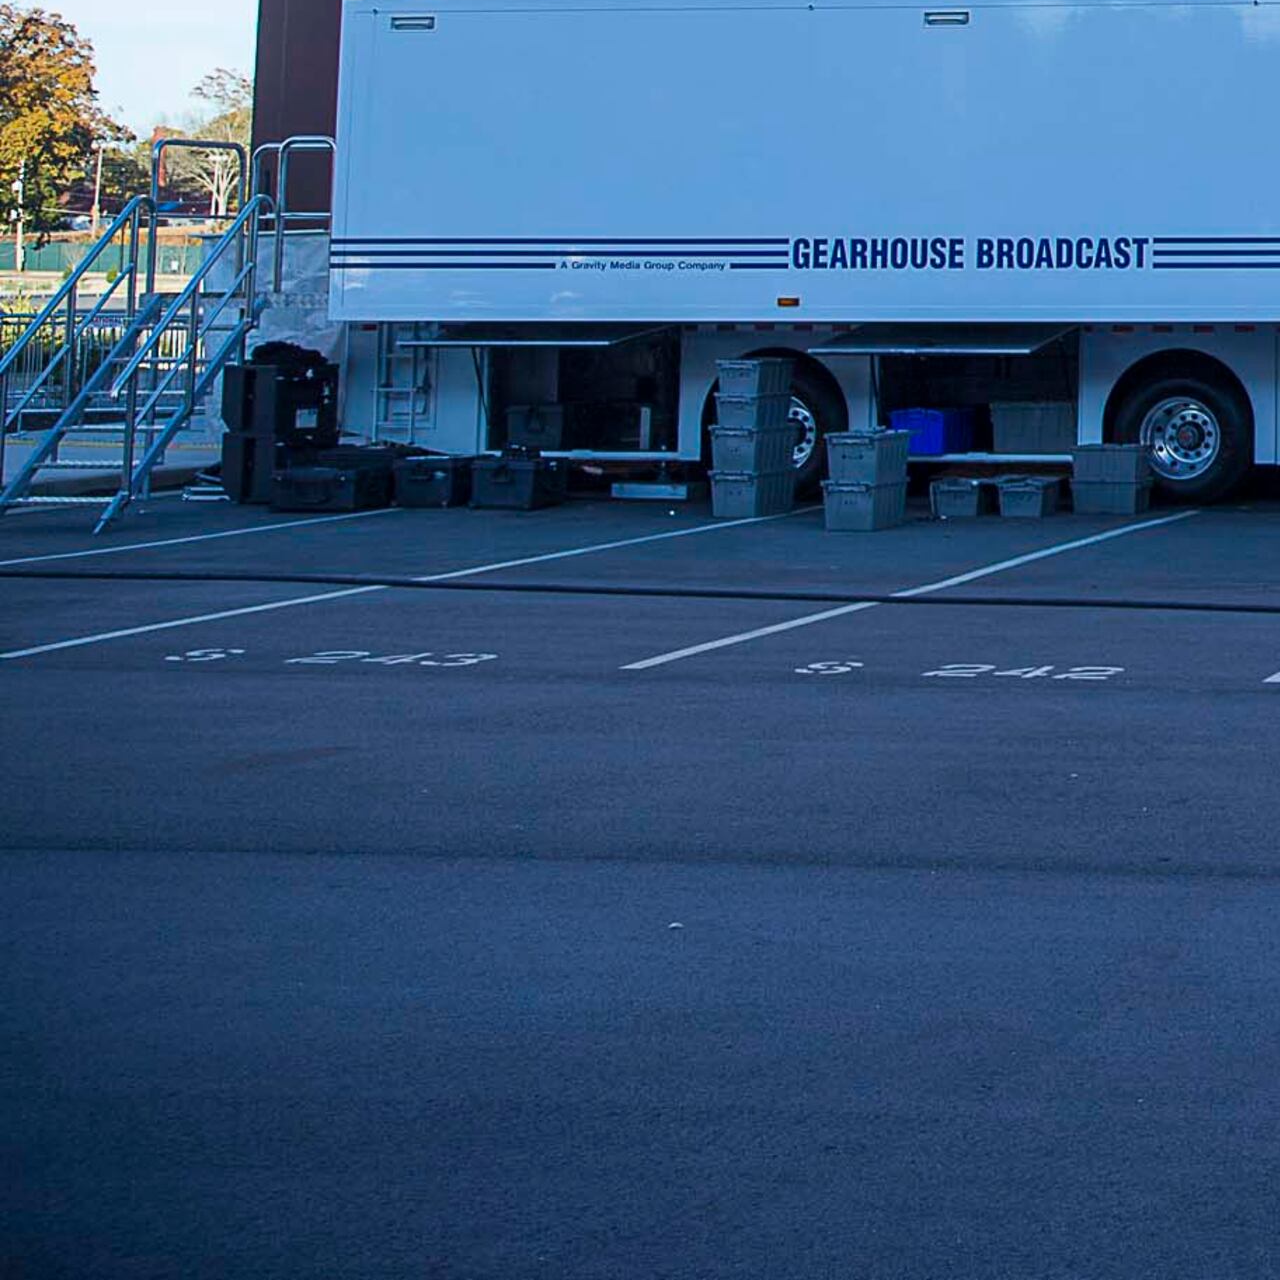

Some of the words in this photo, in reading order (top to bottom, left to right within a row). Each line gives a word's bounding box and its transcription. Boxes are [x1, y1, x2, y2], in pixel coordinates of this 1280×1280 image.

[792, 237, 965, 270] GEARHOUSE
[975, 237, 1149, 270] BROADCAST
[560, 261, 569, 270] A
[571, 261, 606, 272] Gravity
[610, 260, 641, 270] Media
[646, 260, 674, 272] Group
[678, 260, 726, 272] Company
[285, 650, 498, 667] 243
[921, 663, 1125, 681] 242
